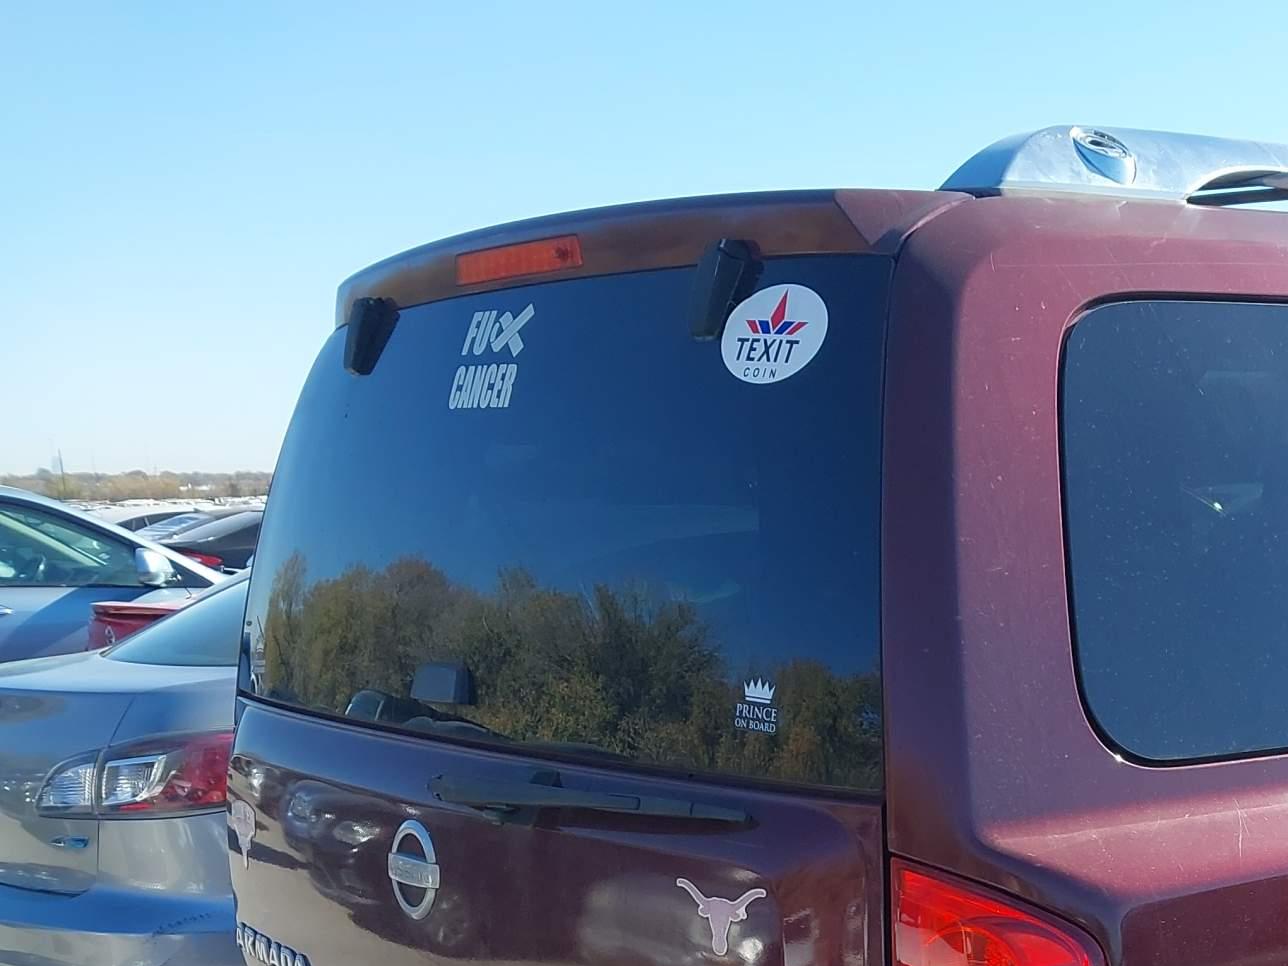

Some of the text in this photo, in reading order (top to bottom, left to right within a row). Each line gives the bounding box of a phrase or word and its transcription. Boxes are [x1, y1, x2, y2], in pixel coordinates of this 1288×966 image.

[736, 337, 800, 363] TEXIT
[743, 367, 777, 379] COIN
[448, 363, 517, 409] CANCER
[736, 703, 777, 721] PRINCE
[735, 717, 776, 733] ON BOARD
